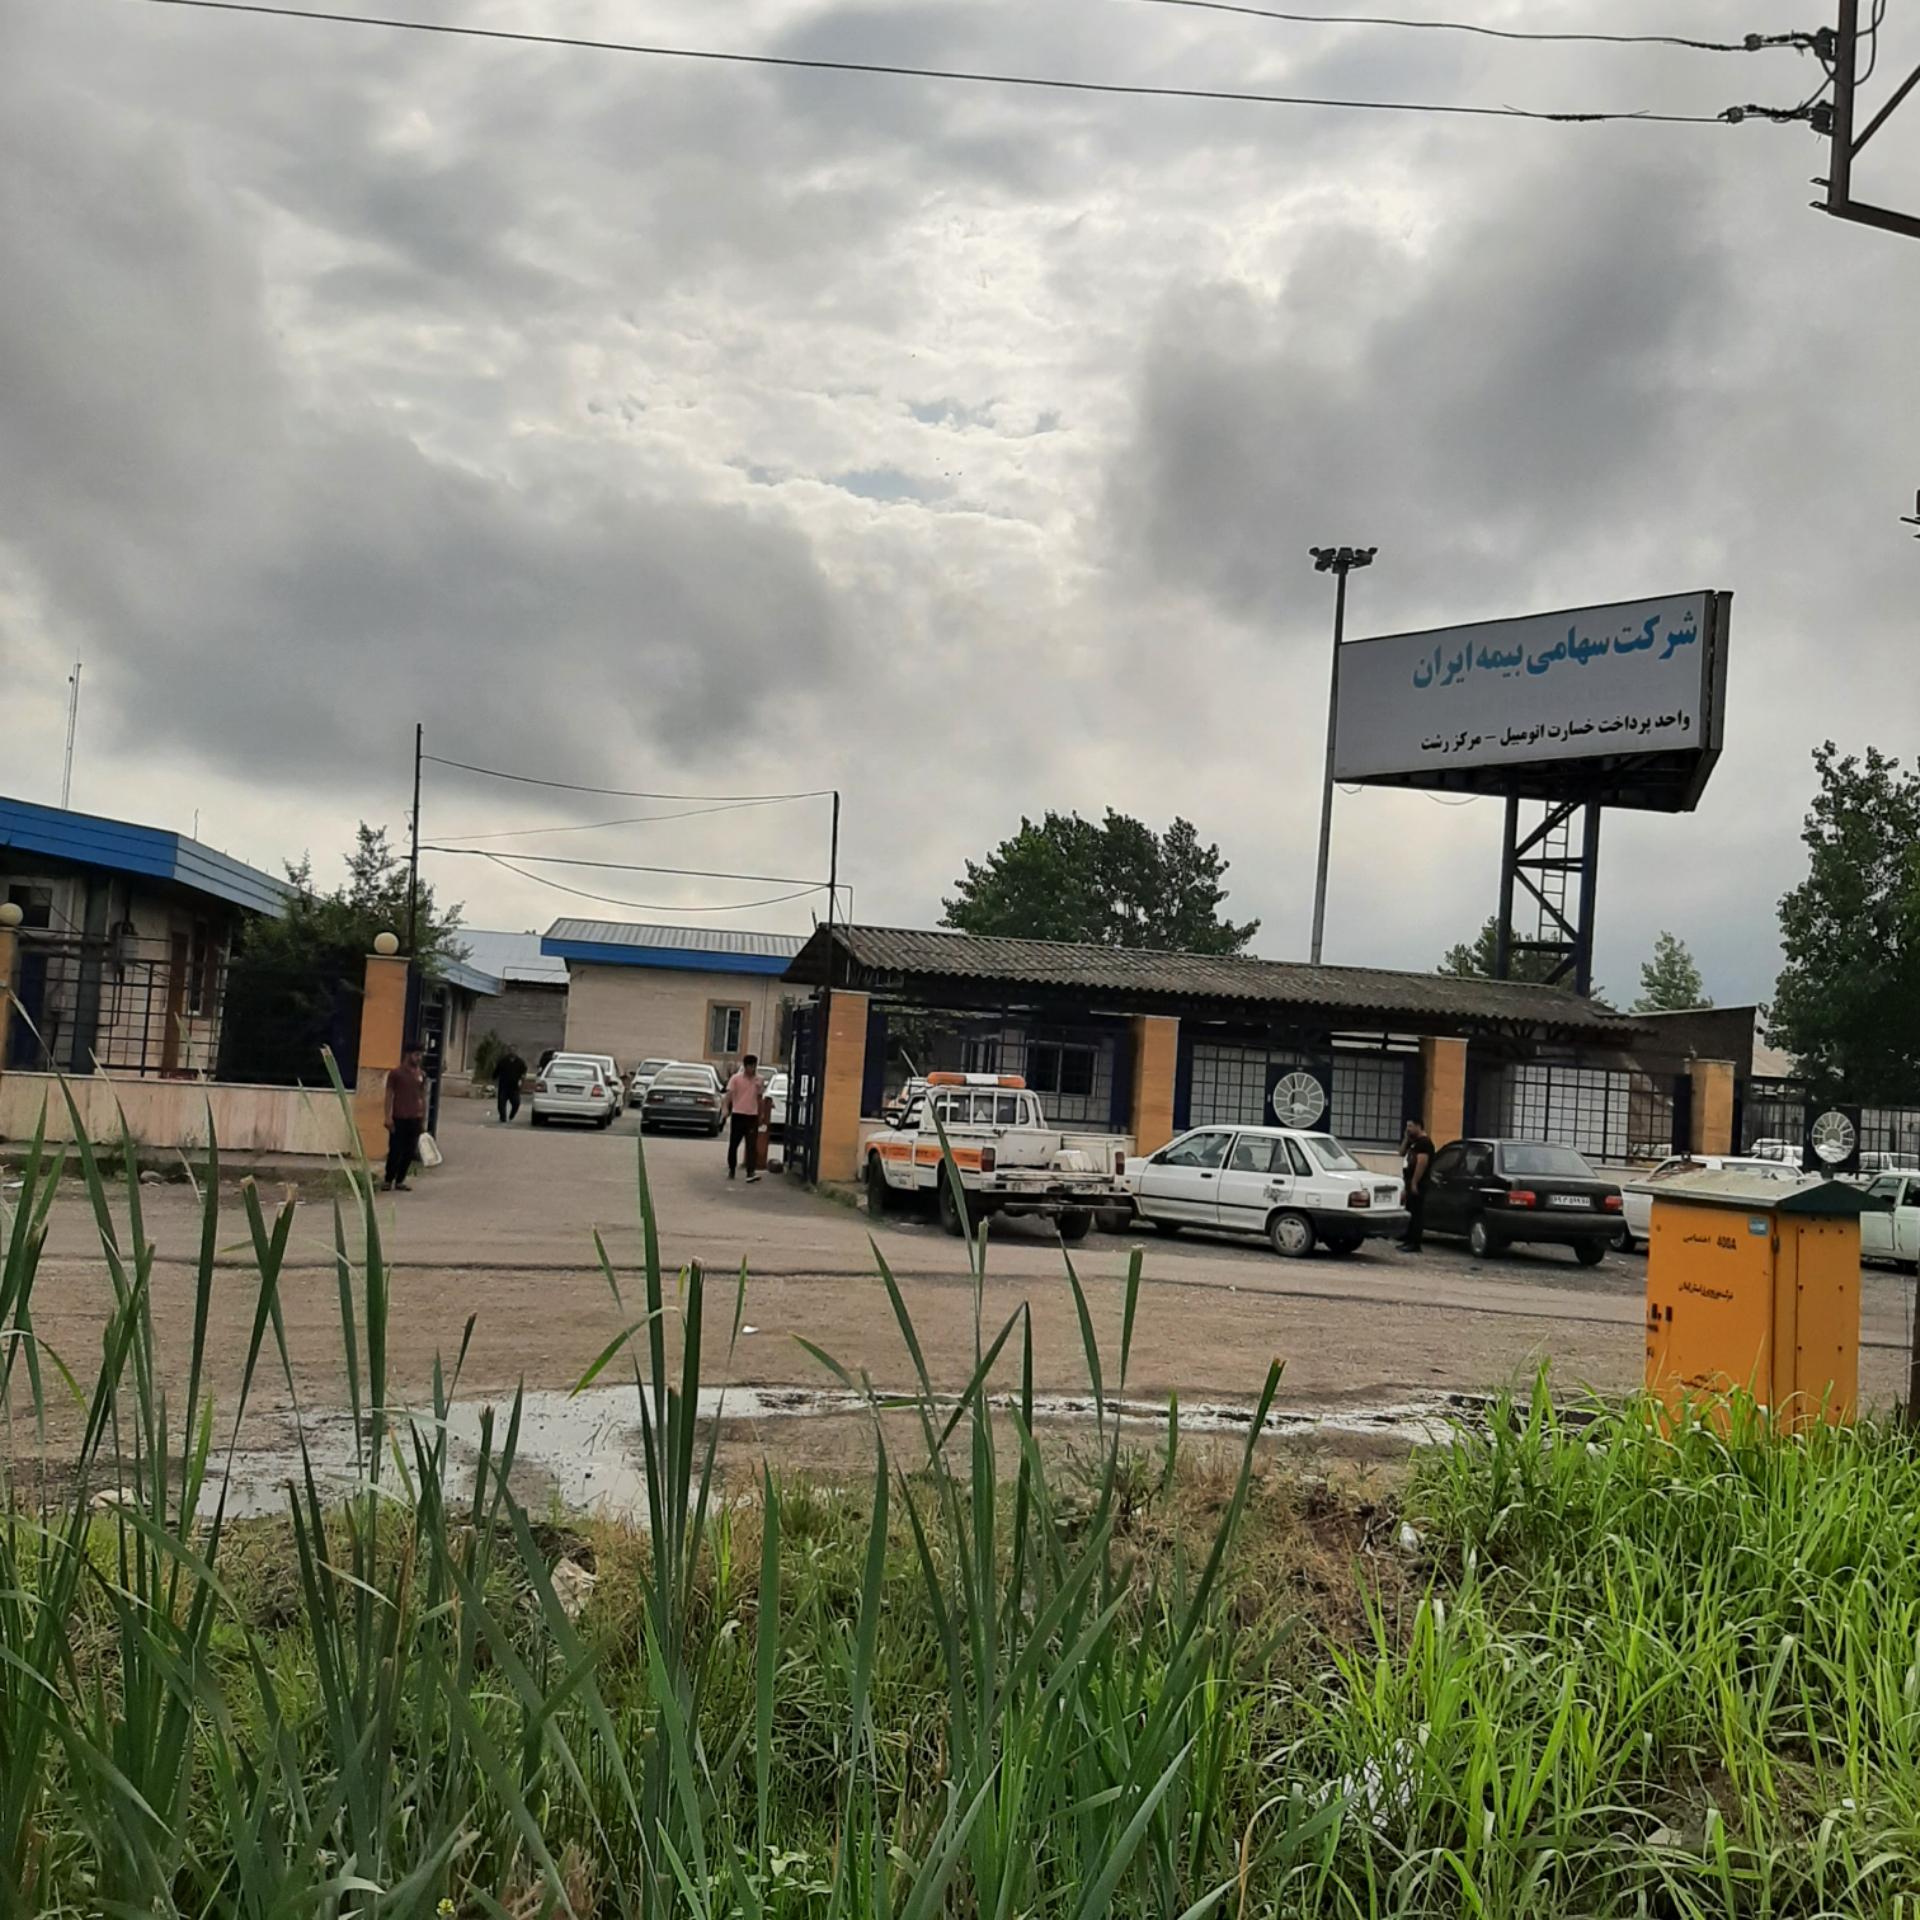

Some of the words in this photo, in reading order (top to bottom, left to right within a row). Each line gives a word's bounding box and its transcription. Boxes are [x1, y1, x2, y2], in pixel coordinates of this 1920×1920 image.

[1614, 610, 1698, 660] شرکت
[1475, 643, 1524, 678] بیمه
[1526, 625, 1610, 675] سهامی
[1412, 639, 1473, 689] ایران
[1547, 718, 1595, 743] خسارت
[1598, 714, 1651, 736] پرداخت
[1654, 709, 1691, 731] واحد
[1420, 733, 1450, 754] رشت
[1452, 731, 1482, 753] مرکز
[1499, 723, 1545, 747] اتومبیل
